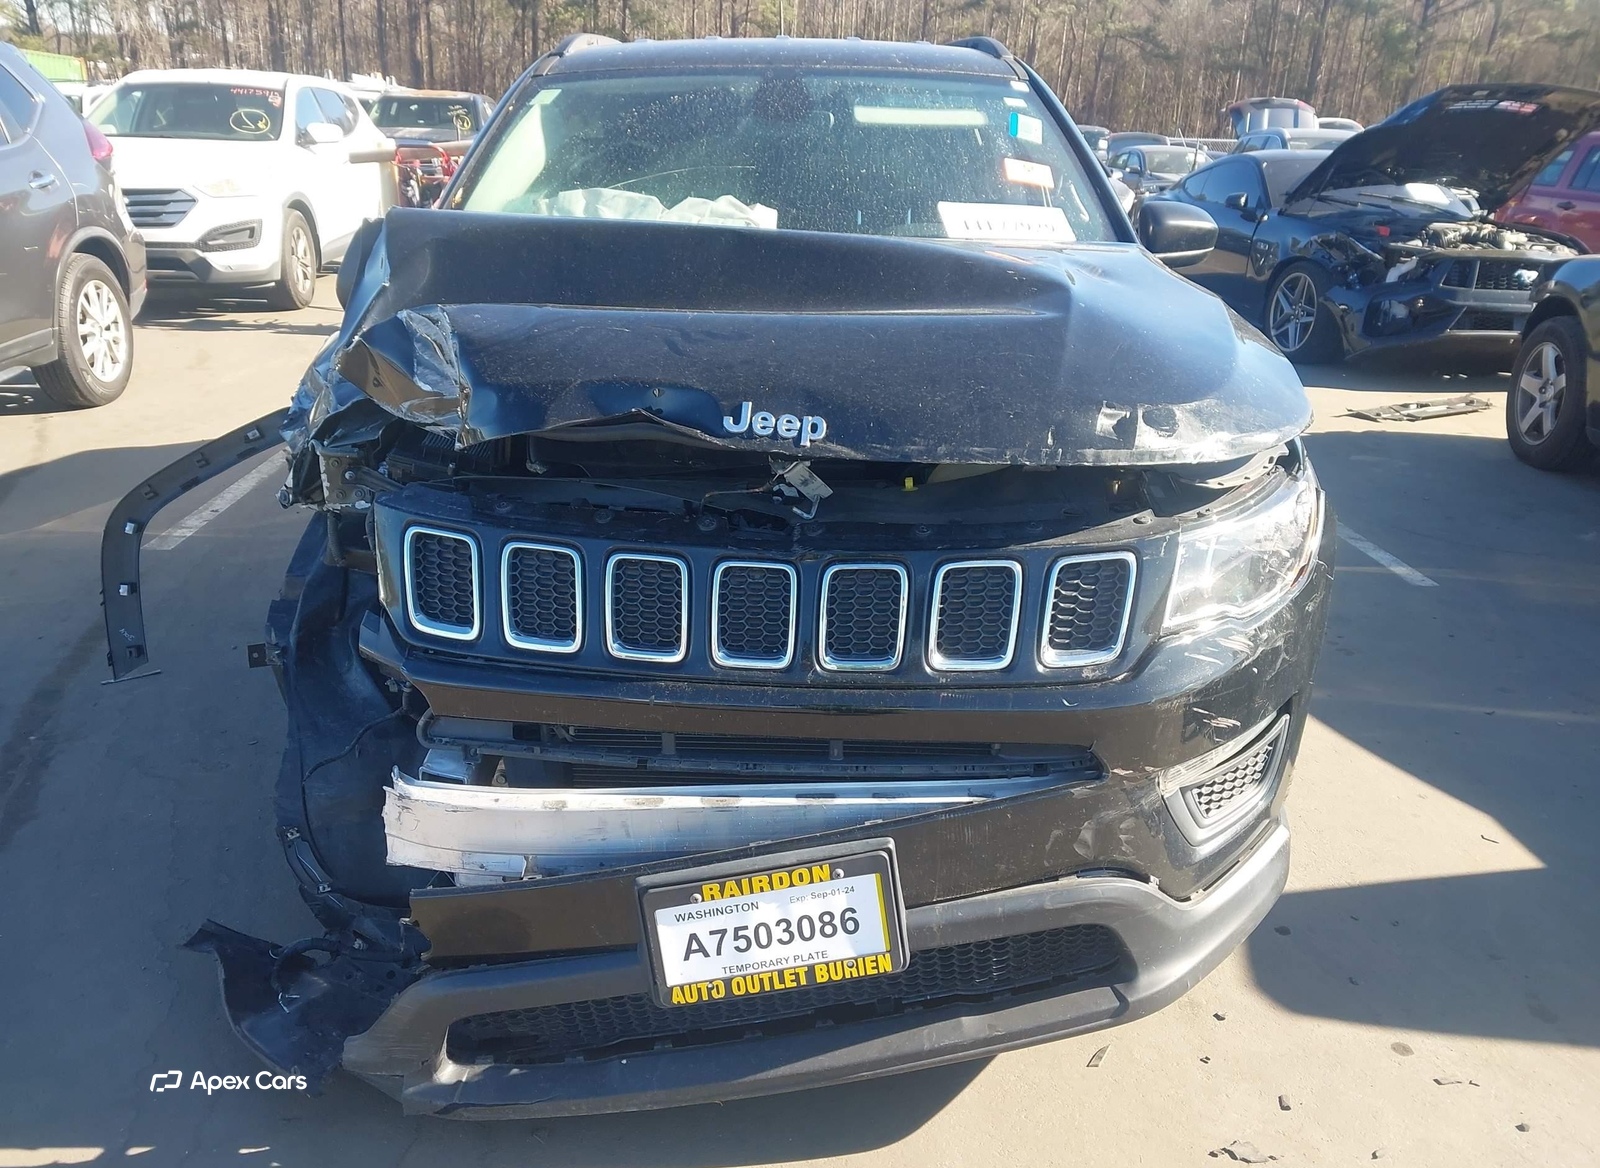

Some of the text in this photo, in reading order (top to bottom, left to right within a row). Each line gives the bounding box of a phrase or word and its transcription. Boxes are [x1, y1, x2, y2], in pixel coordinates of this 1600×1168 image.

[723, 401, 827, 447] Jeep
[702, 864, 830, 900] RAIRDON
[810, 886, 855, 900] Sep-01-24
[674, 901, 759, 922] WASHINGTON
[683, 907, 860, 961] A7503086
[671, 953, 892, 1005] AUTO OUTLET BURIEN
[721, 950, 828, 975] TEMPORARY PLATE
